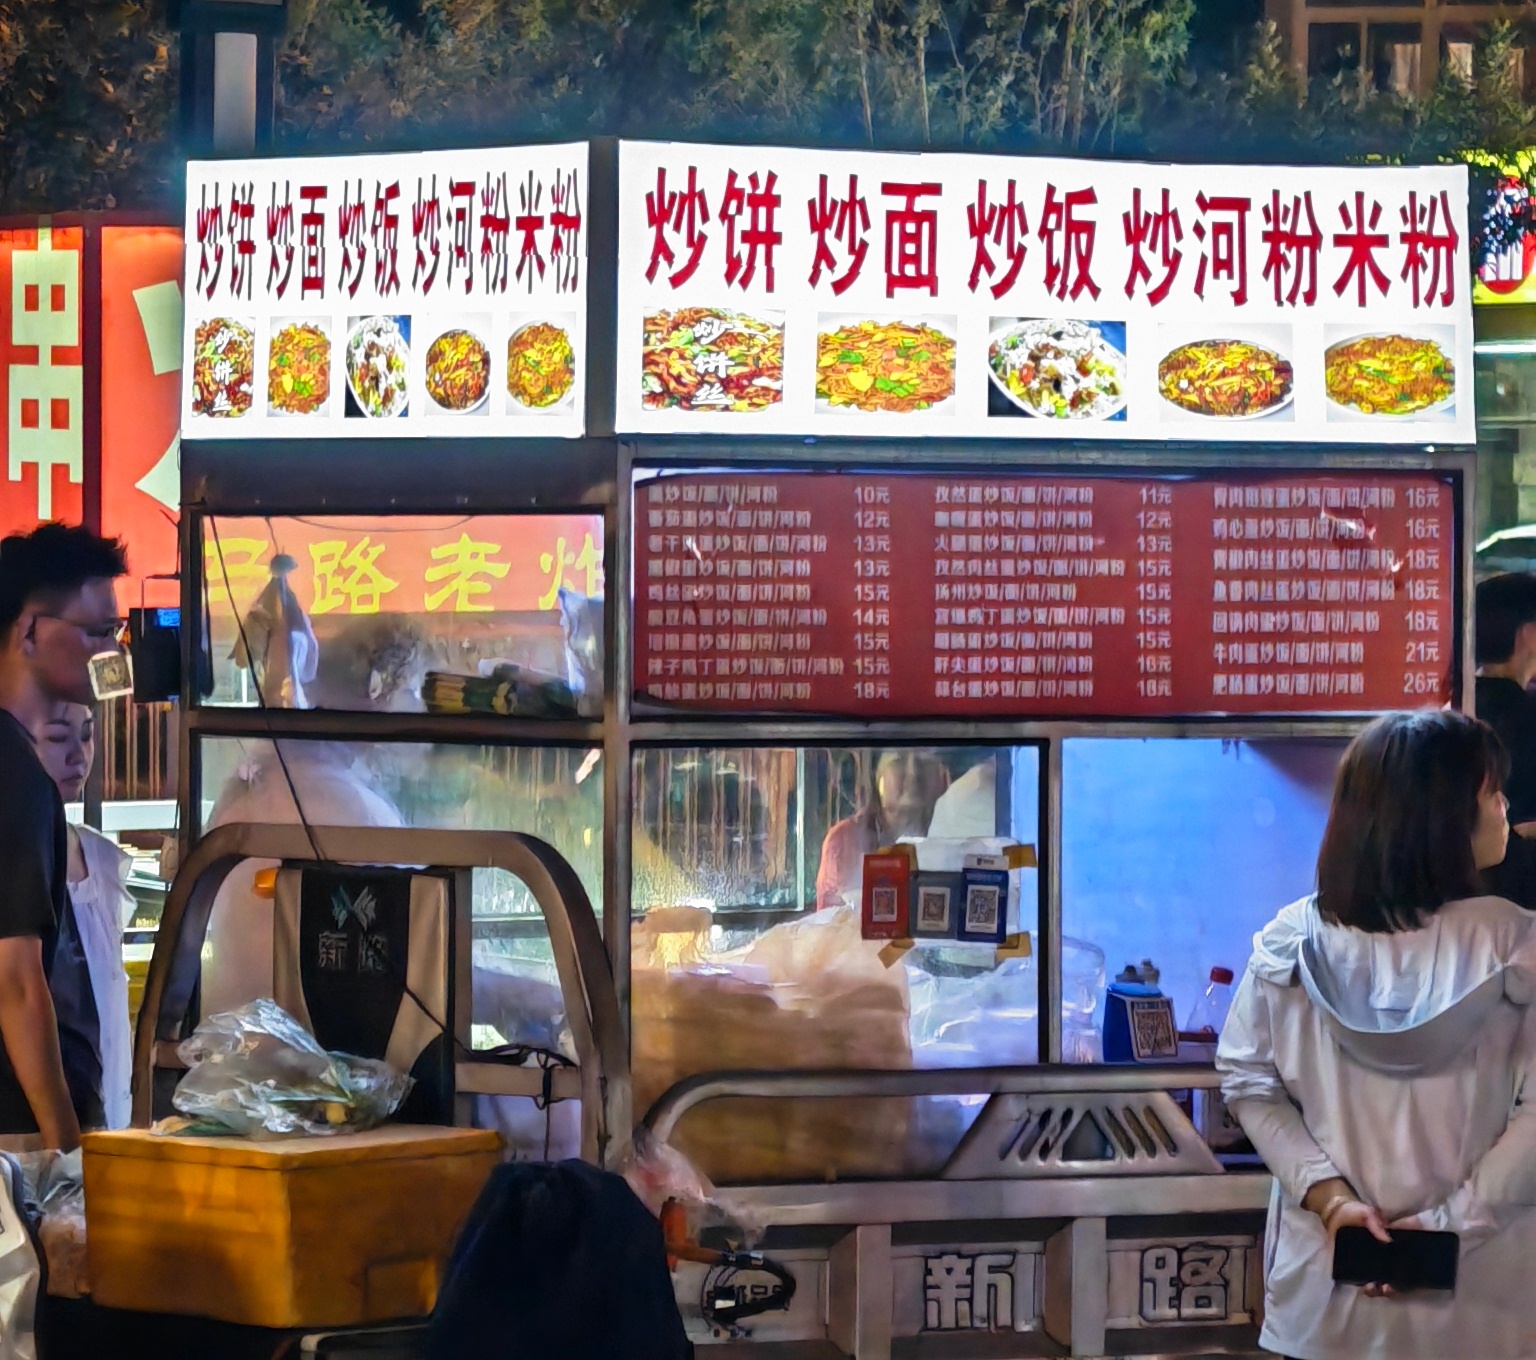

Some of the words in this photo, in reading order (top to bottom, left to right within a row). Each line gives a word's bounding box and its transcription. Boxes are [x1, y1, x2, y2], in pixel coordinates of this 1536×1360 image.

[195, 181, 256, 302] 炒饼
[265, 180, 328, 301] 炒面
[337, 178, 401, 300] 炒饭
[411, 167, 581, 298] 炒河粉米粉
[643, 166, 784, 294] 炒饼
[806, 173, 943, 299] 炒面
[966, 178, 1102, 303] 炒饭
[1121, 185, 1460, 310] 炒河粉米粉
[853, 485, 889, 503] 10元
[1137, 485, 1171, 503] 11元
[1405, 487, 1440, 508] 16元
[853, 510, 889, 527] 12元
[1137, 511, 1171, 527] 12元
[1405, 518, 1440, 539] 16元
[1137, 535, 1171, 553] 13元
[1405, 549, 1440, 571] 18元
[853, 584, 889, 600] 15元
[1405, 580, 1440, 601] 18元
[853, 608, 889, 625] 14元
[1405, 611, 1440, 632] 18元
[853, 633, 889, 650] 15元
[1405, 642, 1440, 663] 21元
[853, 658, 889, 674] 15元
[1405, 673, 1440, 694] 26元
[924, 1251, 1017, 1332] 新
[1139, 1244, 1232, 1322] 路
